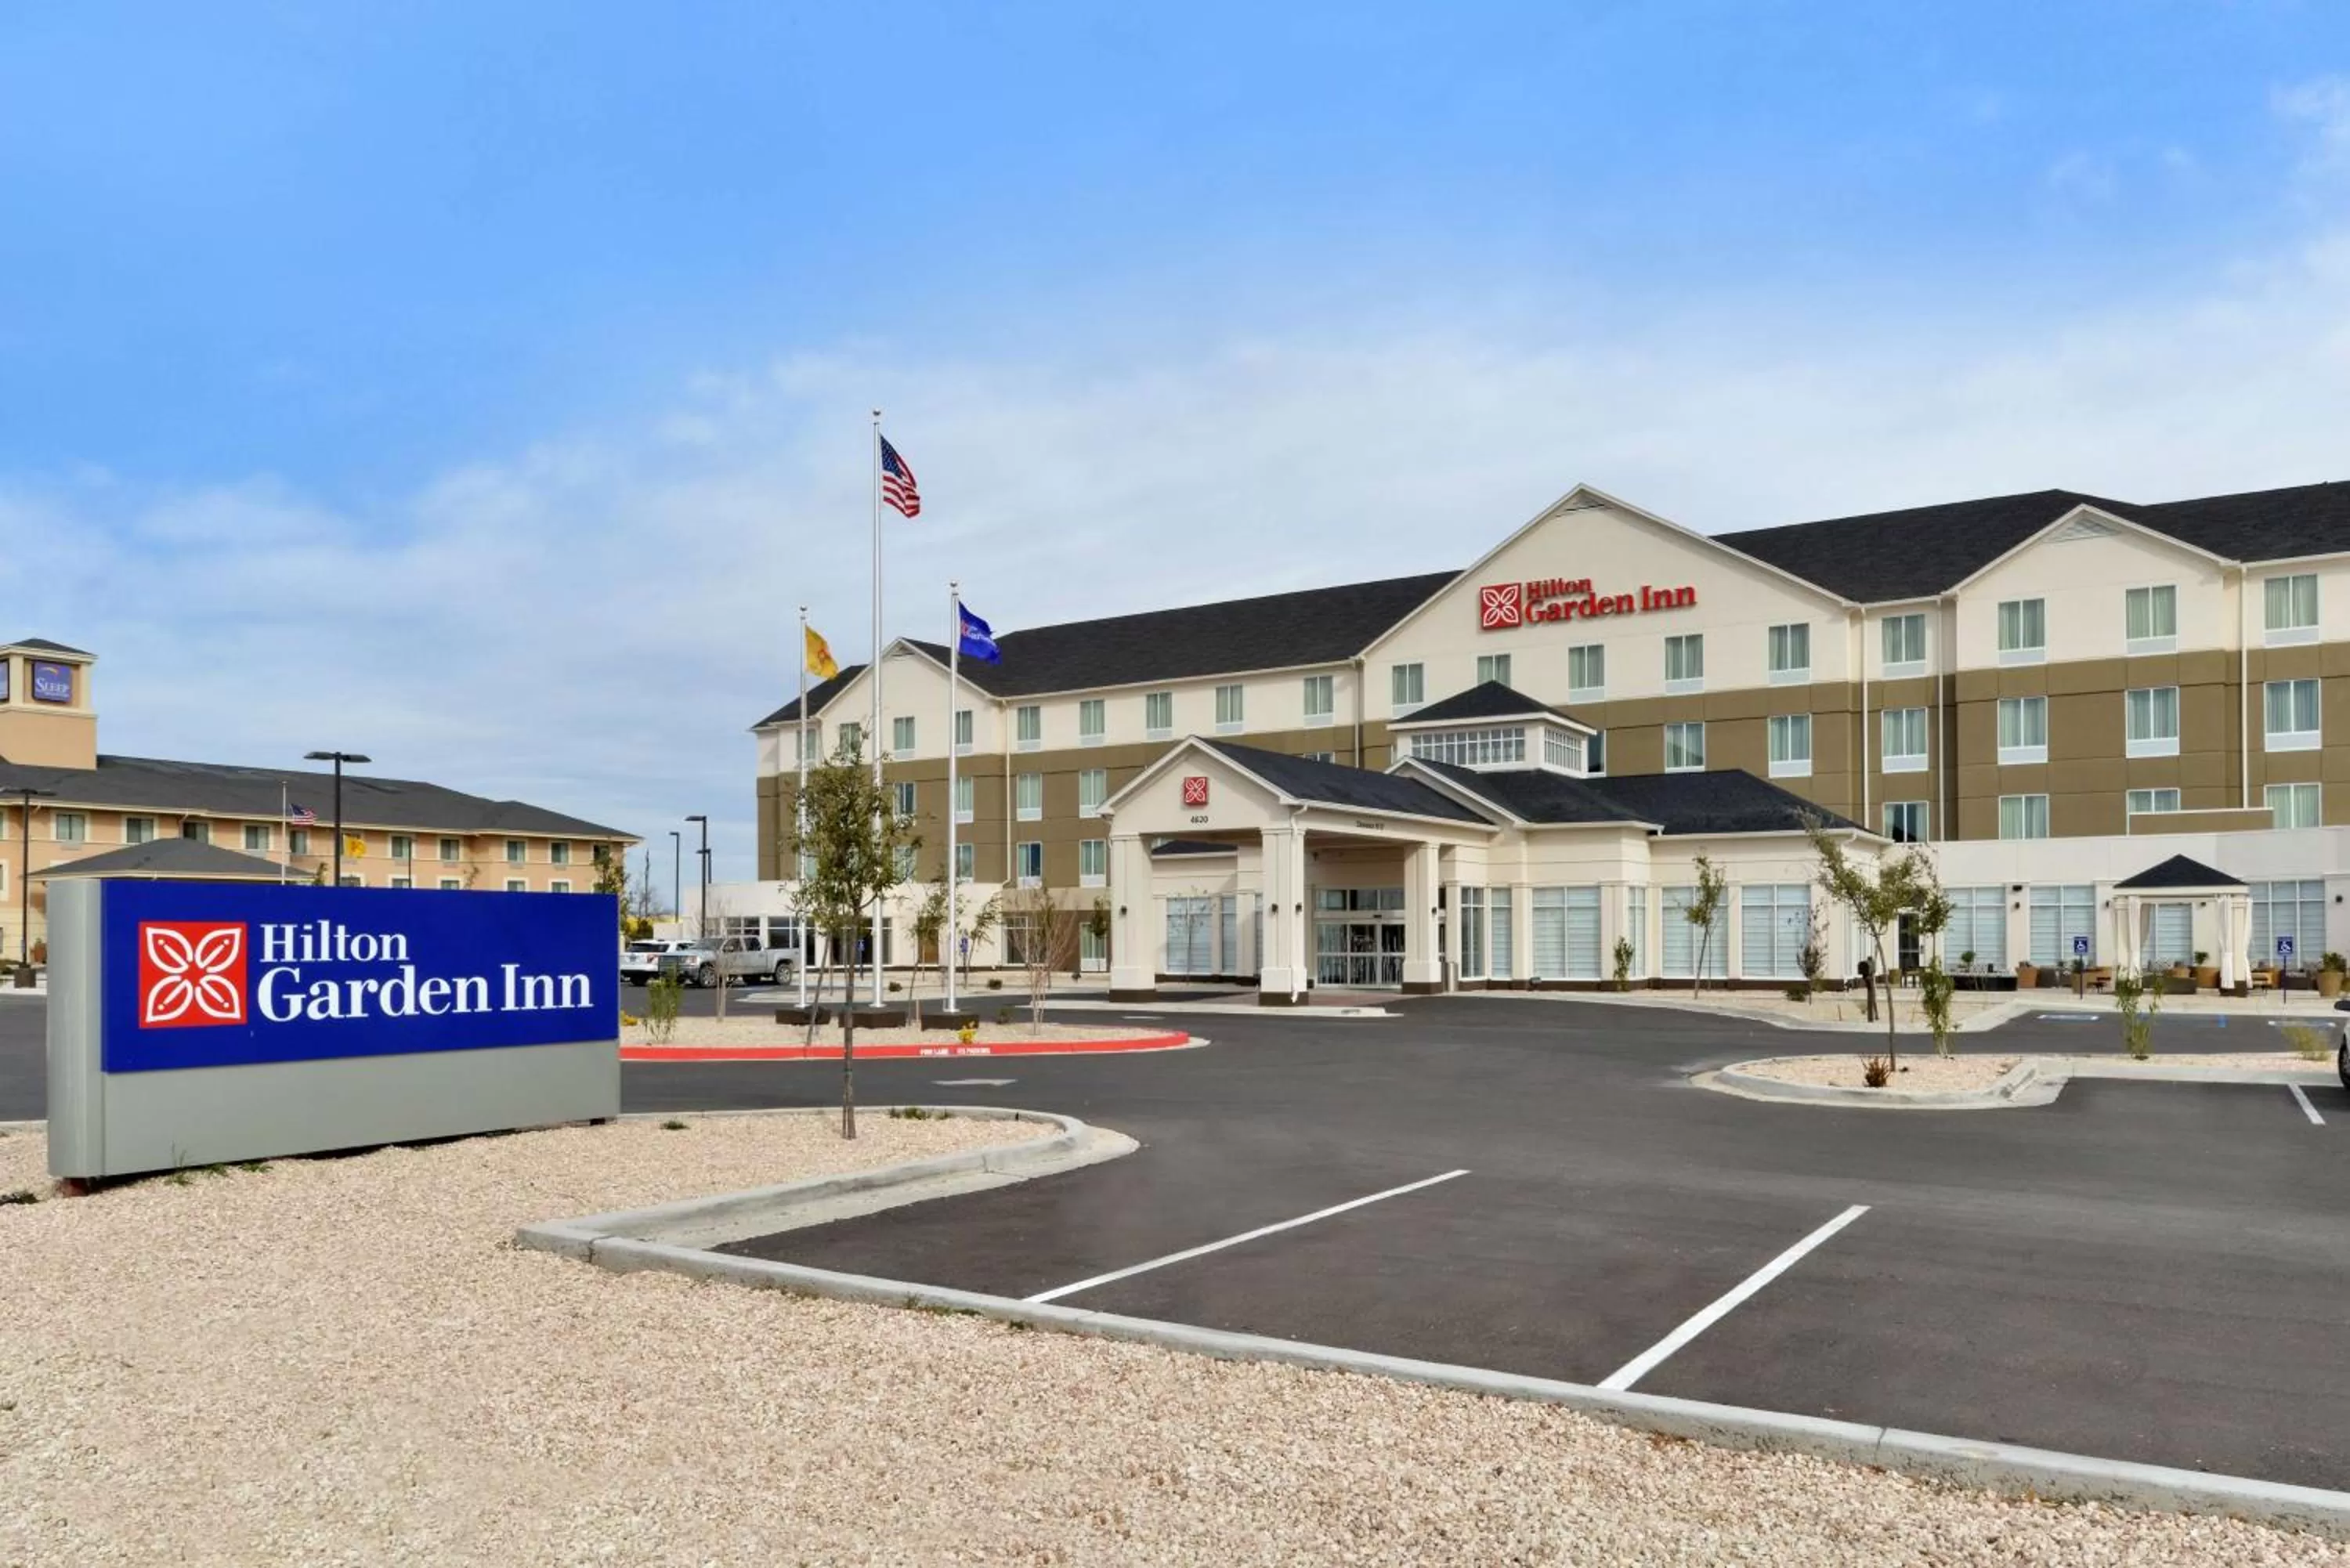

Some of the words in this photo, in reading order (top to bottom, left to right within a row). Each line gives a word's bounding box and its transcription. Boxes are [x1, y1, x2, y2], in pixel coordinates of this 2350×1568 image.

[1525, 592, 1635, 623] Garden
[1640, 585, 1697, 611] Inn
[1526, 578, 1592, 598] Hilton
[259, 919, 410, 963] Hilton
[257, 964, 493, 1022] Garden
[501, 963, 595, 1012] Inn
